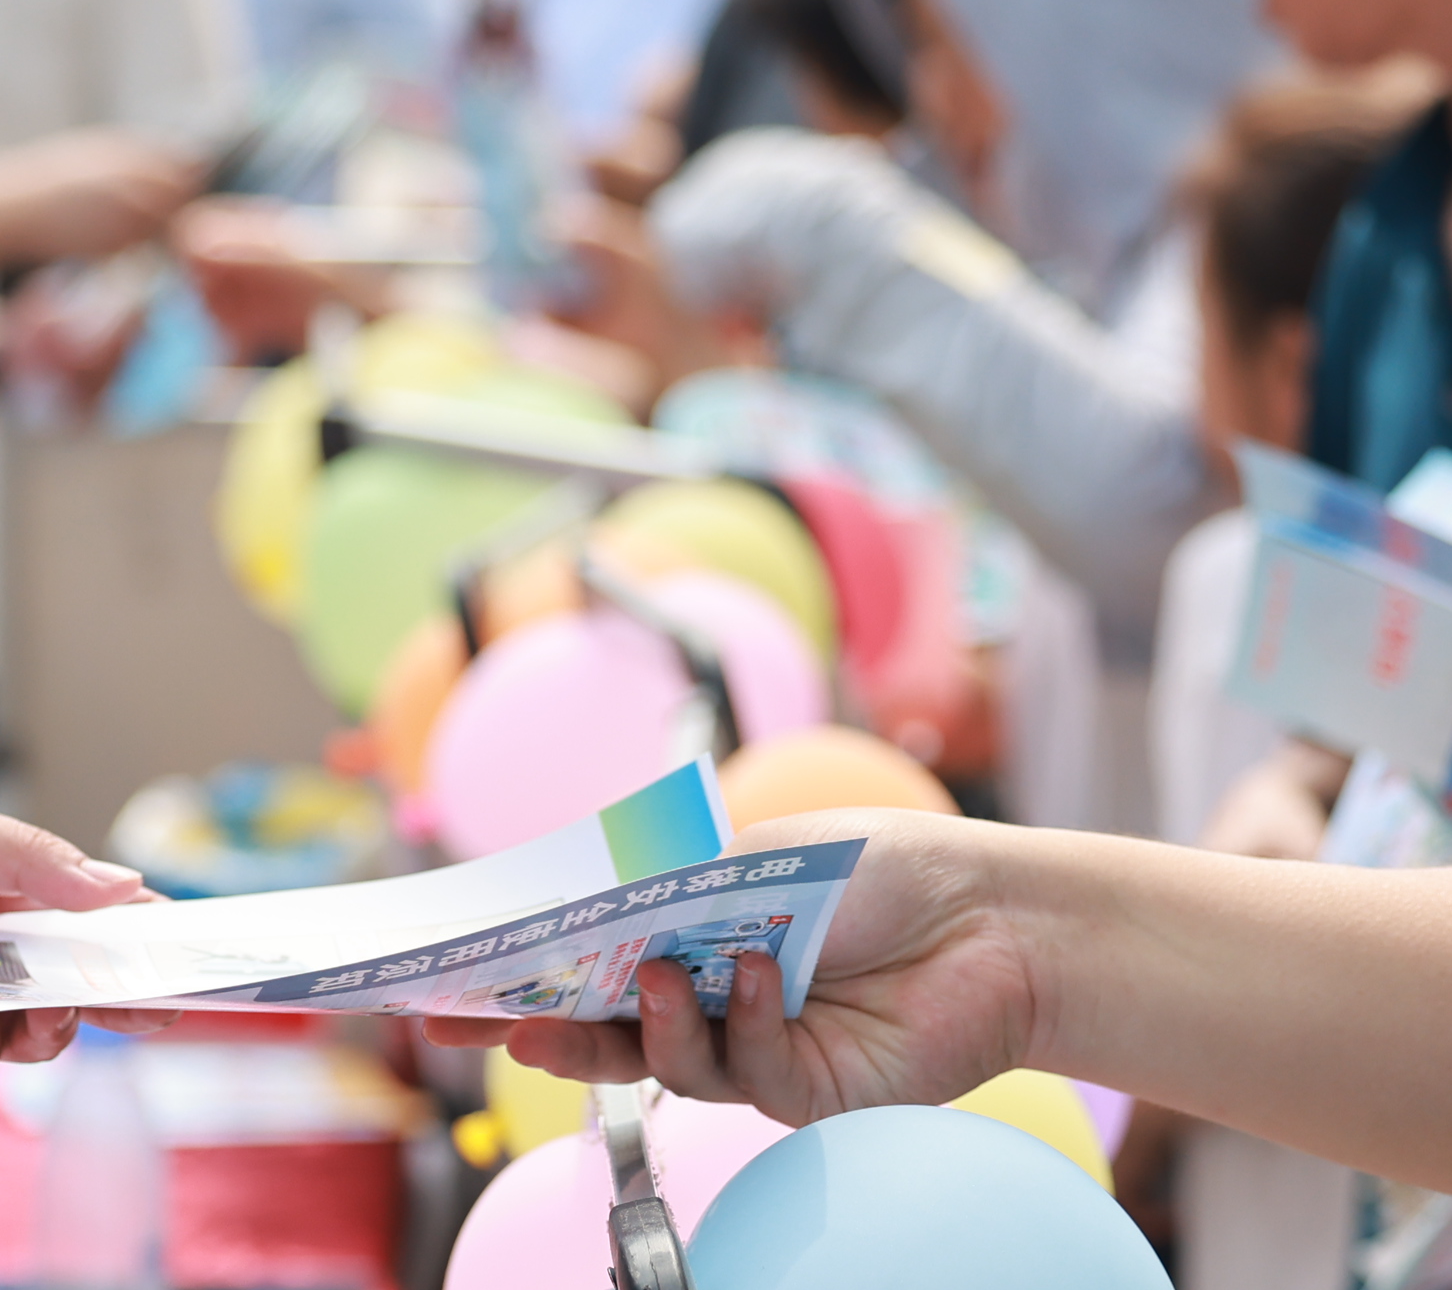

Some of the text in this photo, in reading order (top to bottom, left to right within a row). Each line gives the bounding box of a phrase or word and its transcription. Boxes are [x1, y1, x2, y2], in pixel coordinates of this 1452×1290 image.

[309, 856, 807, 995] 电梯安全使用须知
